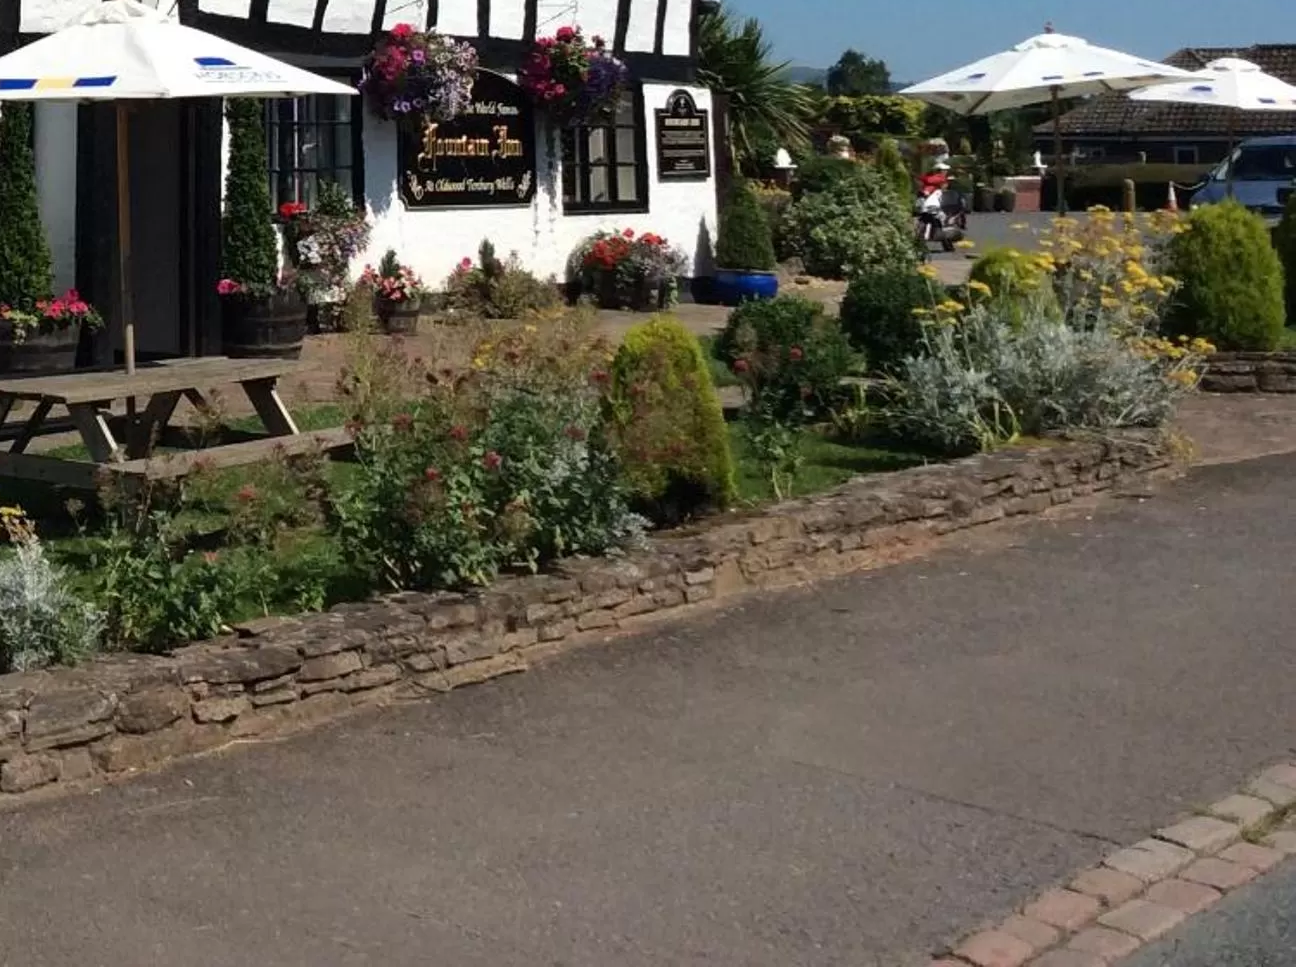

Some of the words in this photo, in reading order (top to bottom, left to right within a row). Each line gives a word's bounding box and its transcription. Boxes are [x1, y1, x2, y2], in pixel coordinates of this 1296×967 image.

[474, 101, 496, 114] World
[418, 118, 490, 171] Fountain
[491, 125, 523, 164] Inn
